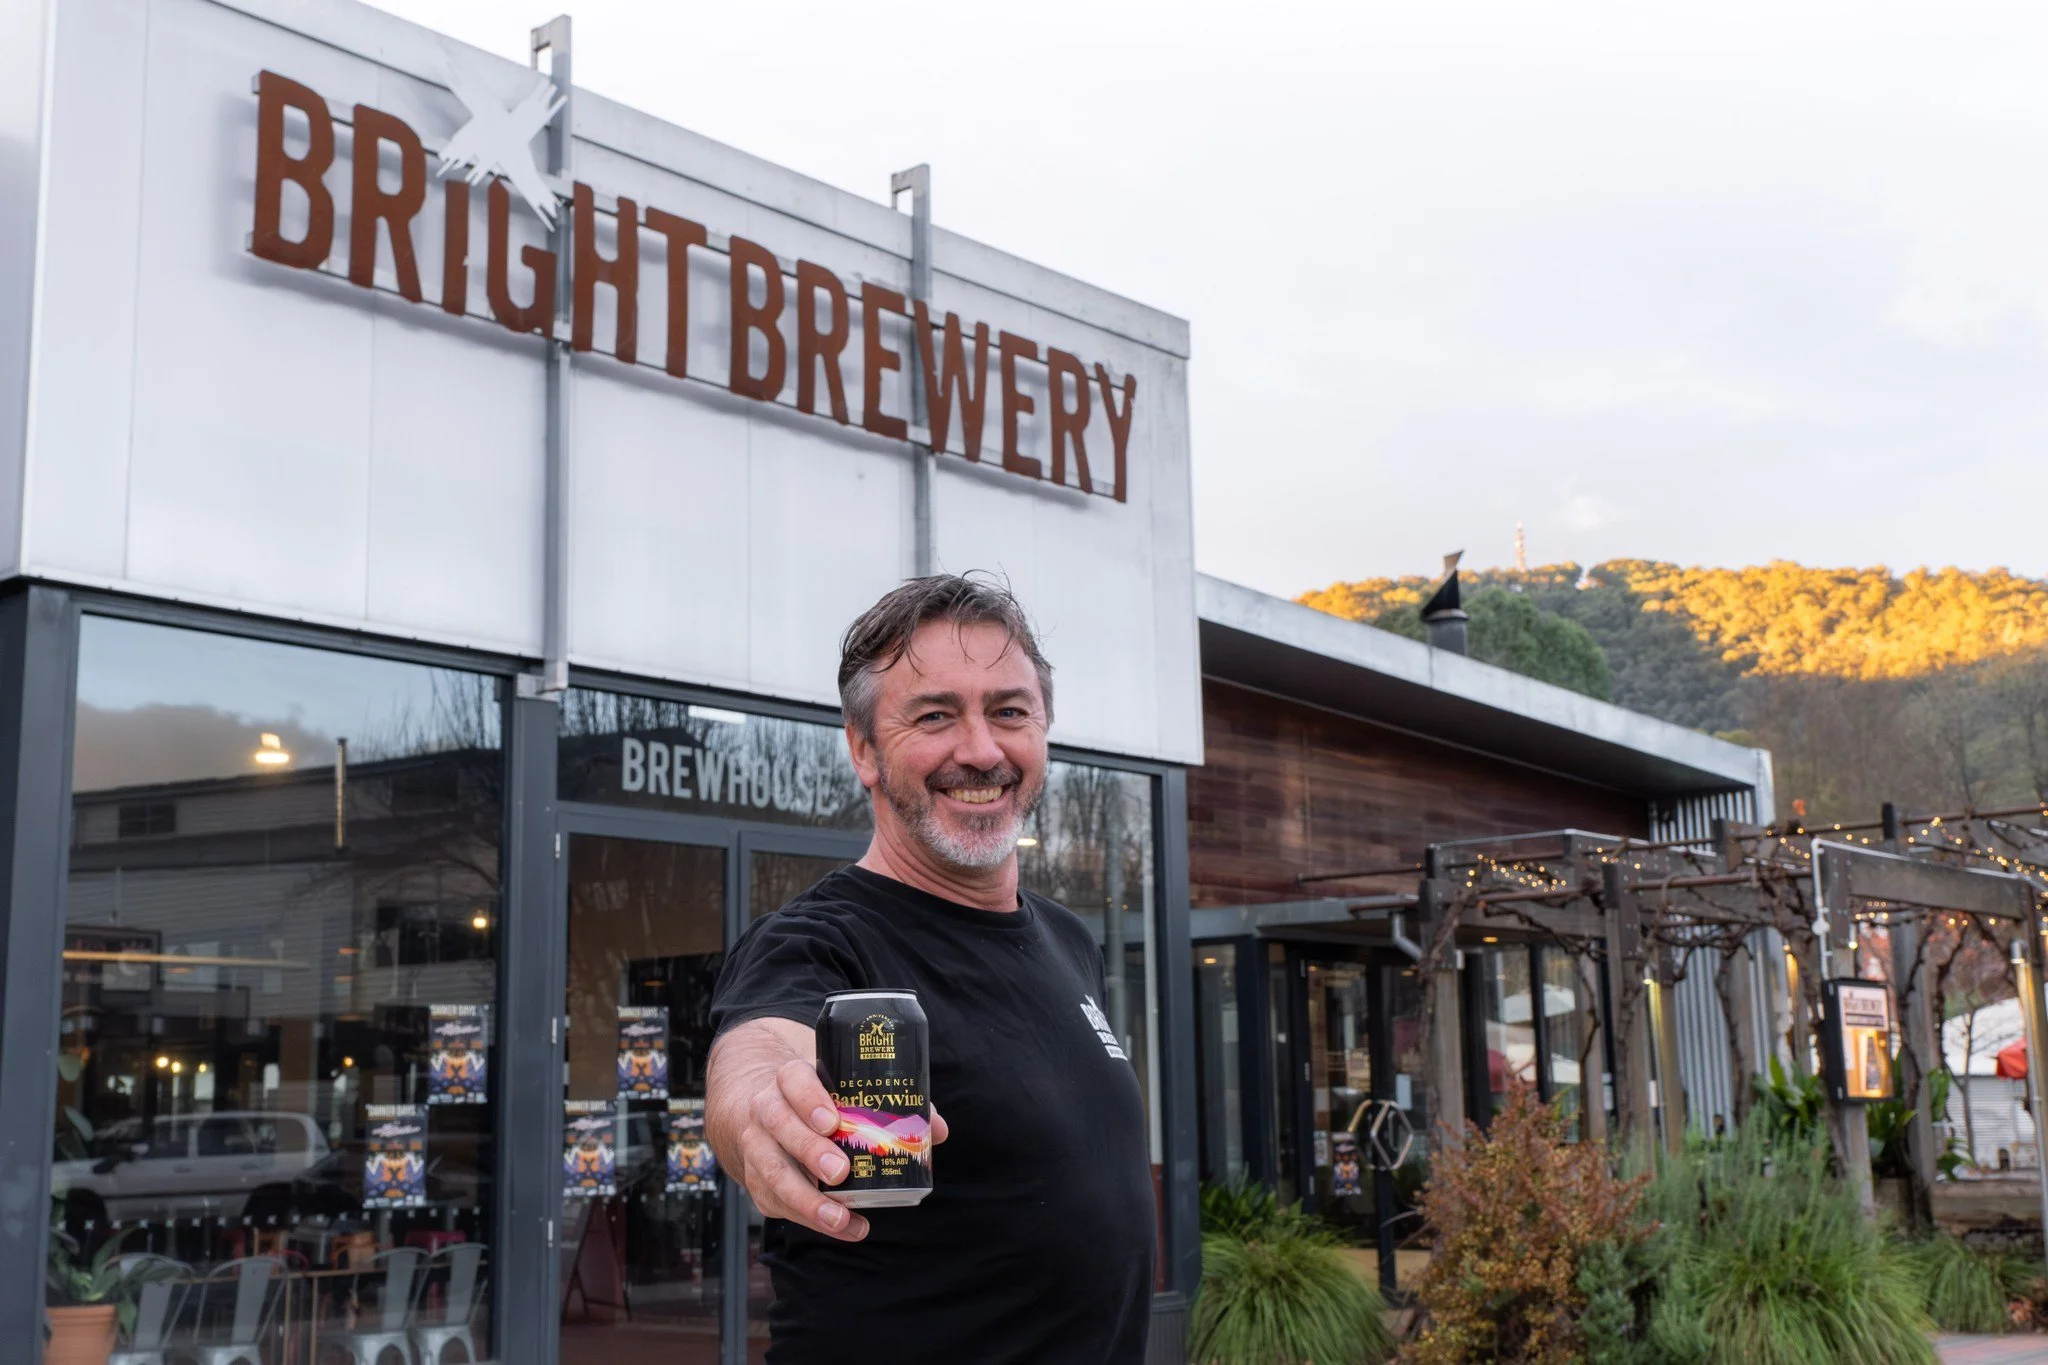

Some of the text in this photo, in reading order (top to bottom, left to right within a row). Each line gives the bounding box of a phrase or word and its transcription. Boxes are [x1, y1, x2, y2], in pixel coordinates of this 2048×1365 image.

[253, 70, 1137, 503] BRIGHT BREWERY
[622, 737, 841, 816] BREWHOUSE
[840, 1078, 915, 1088] DECADENCE
